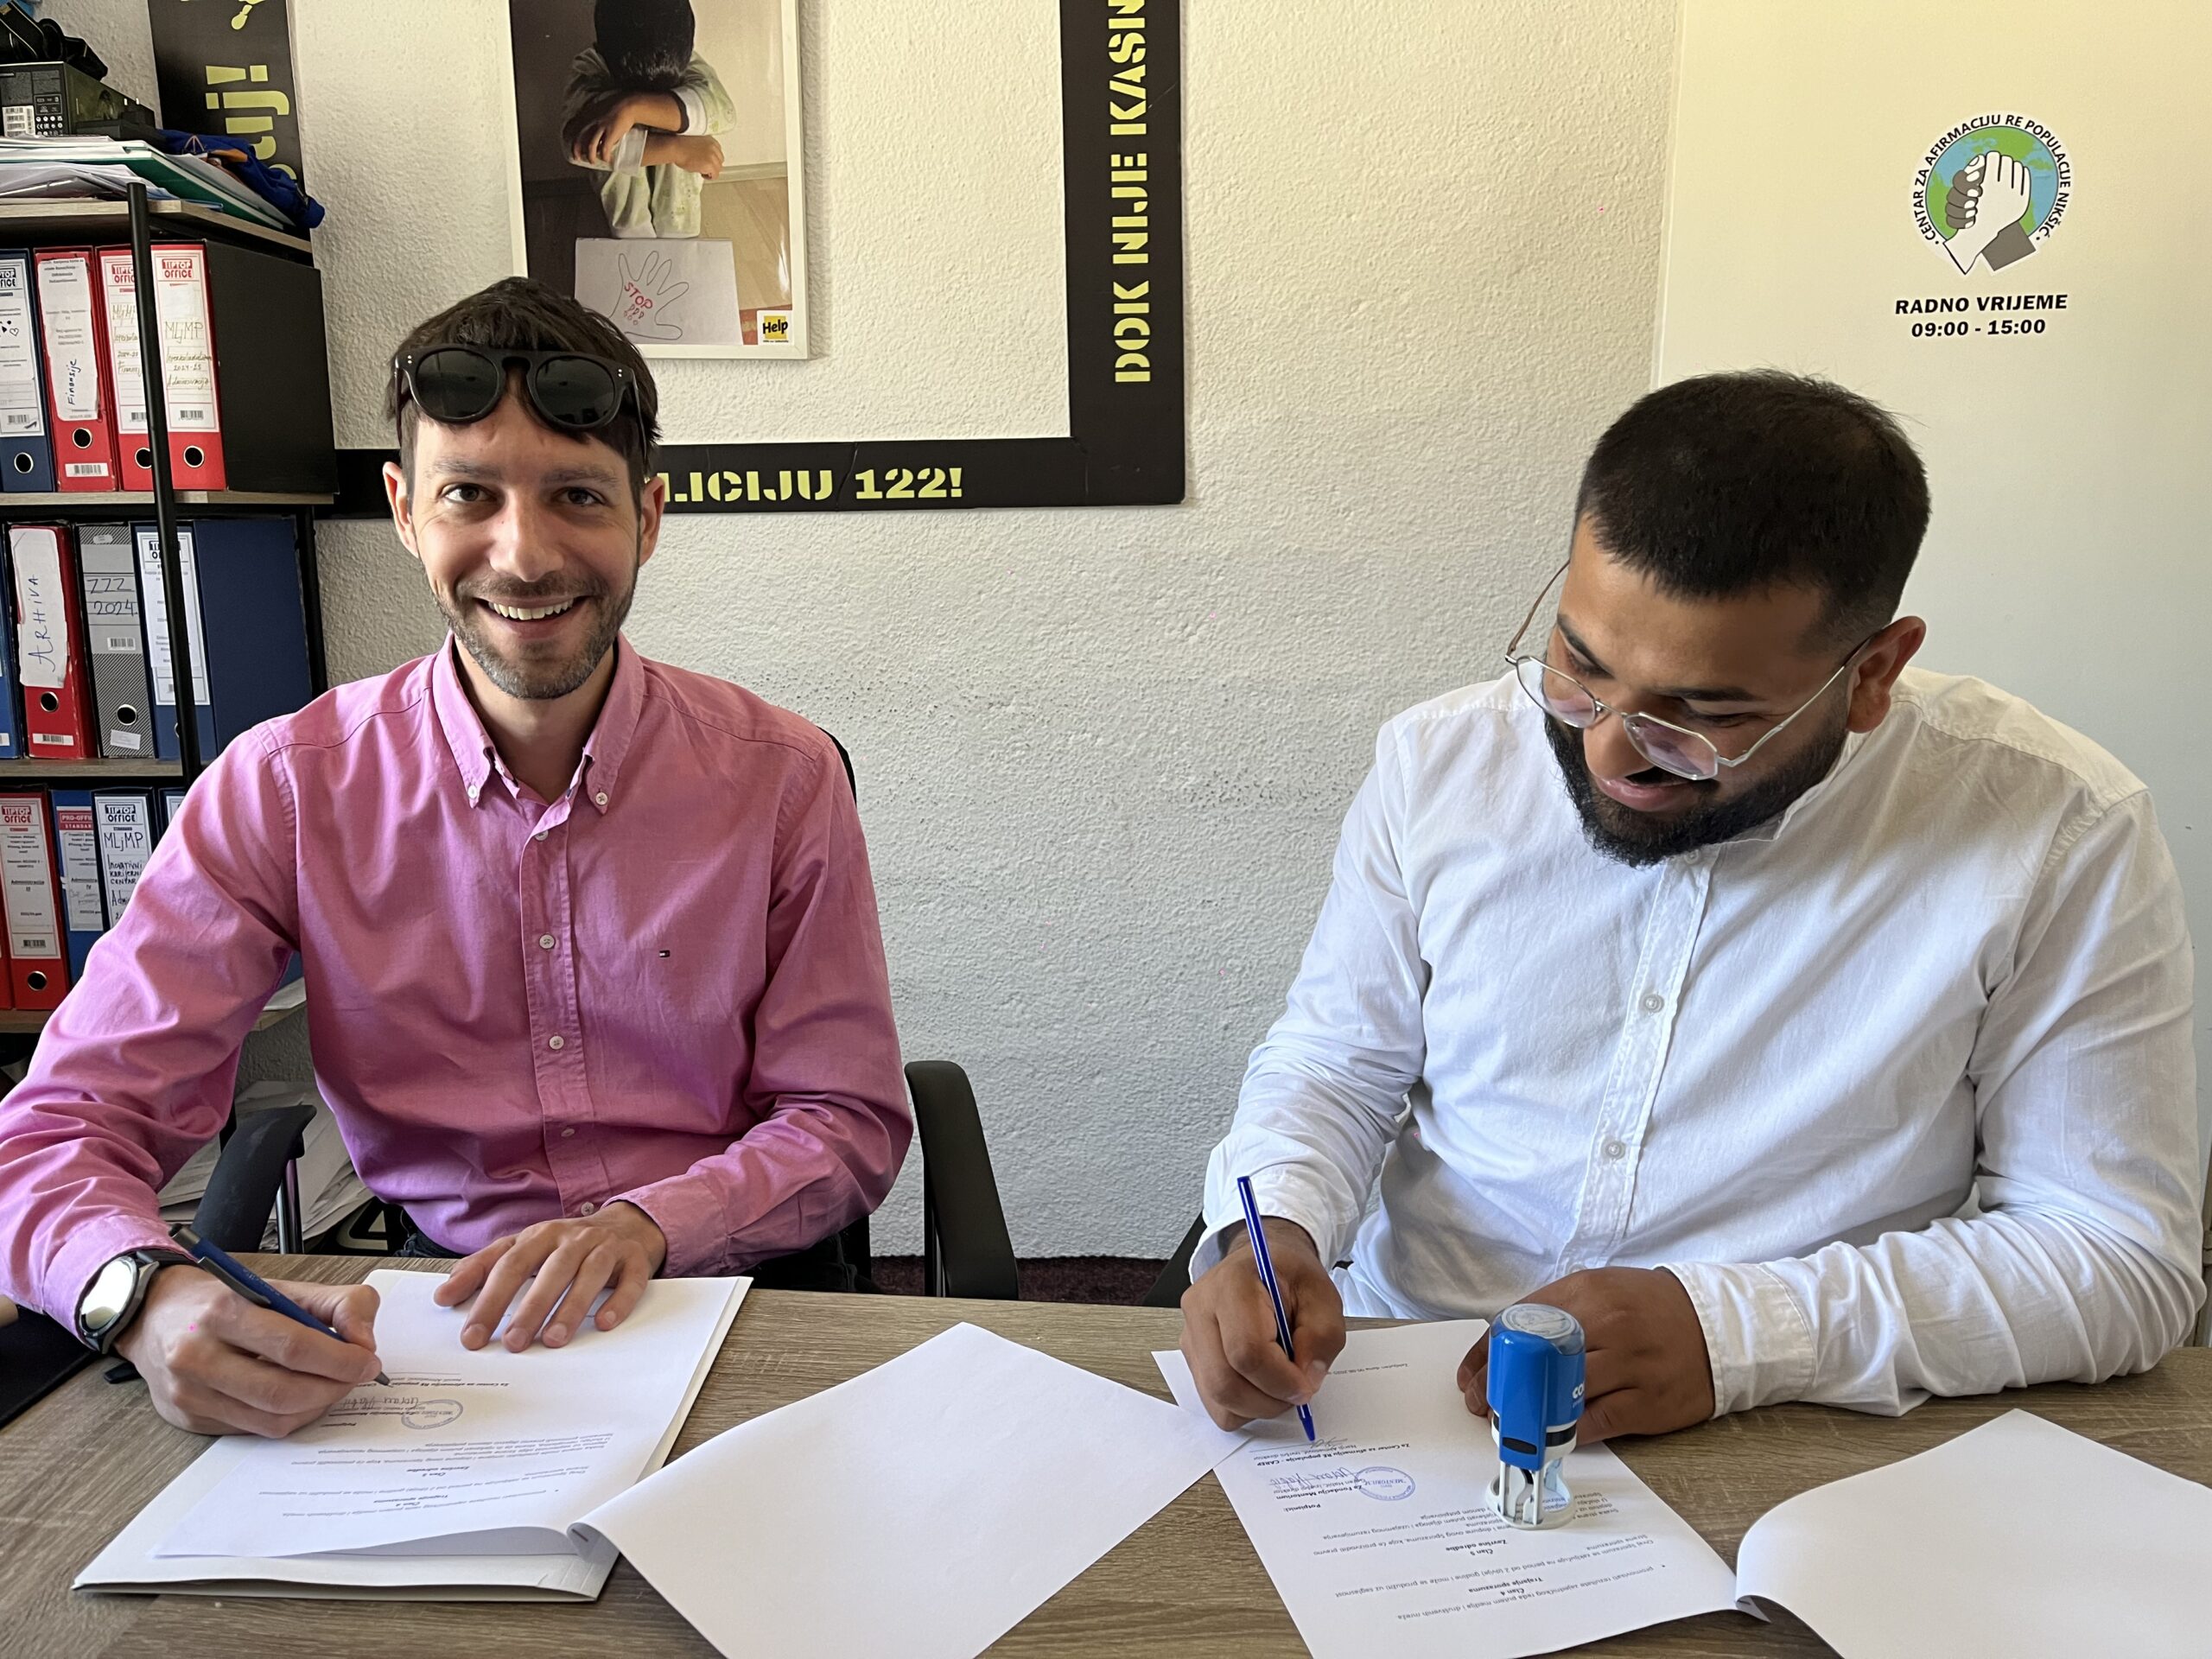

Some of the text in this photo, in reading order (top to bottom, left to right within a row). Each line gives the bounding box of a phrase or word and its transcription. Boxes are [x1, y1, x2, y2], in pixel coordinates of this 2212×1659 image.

[1913, 114, 2071, 241] CENTAR ZA AFIRMACIJU RE POPULACIJE NIKŠIĆ
[1110, 153, 1148, 264] NIJE
[114, 275, 136, 283] OFFIC
[164, 270, 192, 278] OFFICE
[0, 278, 16, 288] FICE
[624, 282, 653, 310] STOP
[1895, 295, 2068, 315] RADNO VRIJEME
[762, 319, 789, 334] Help
[1114, 280, 1151, 383] DOK
[1911, 321, 1968, 337] 09:00
[1988, 320, 2045, 334] 15:00
[855, 467, 963, 499] 122!
[4, 815, 31, 823] OFFICE
[107, 814, 136, 823] OFFICE
[1276, 1491, 1316, 1500] Mentorium
